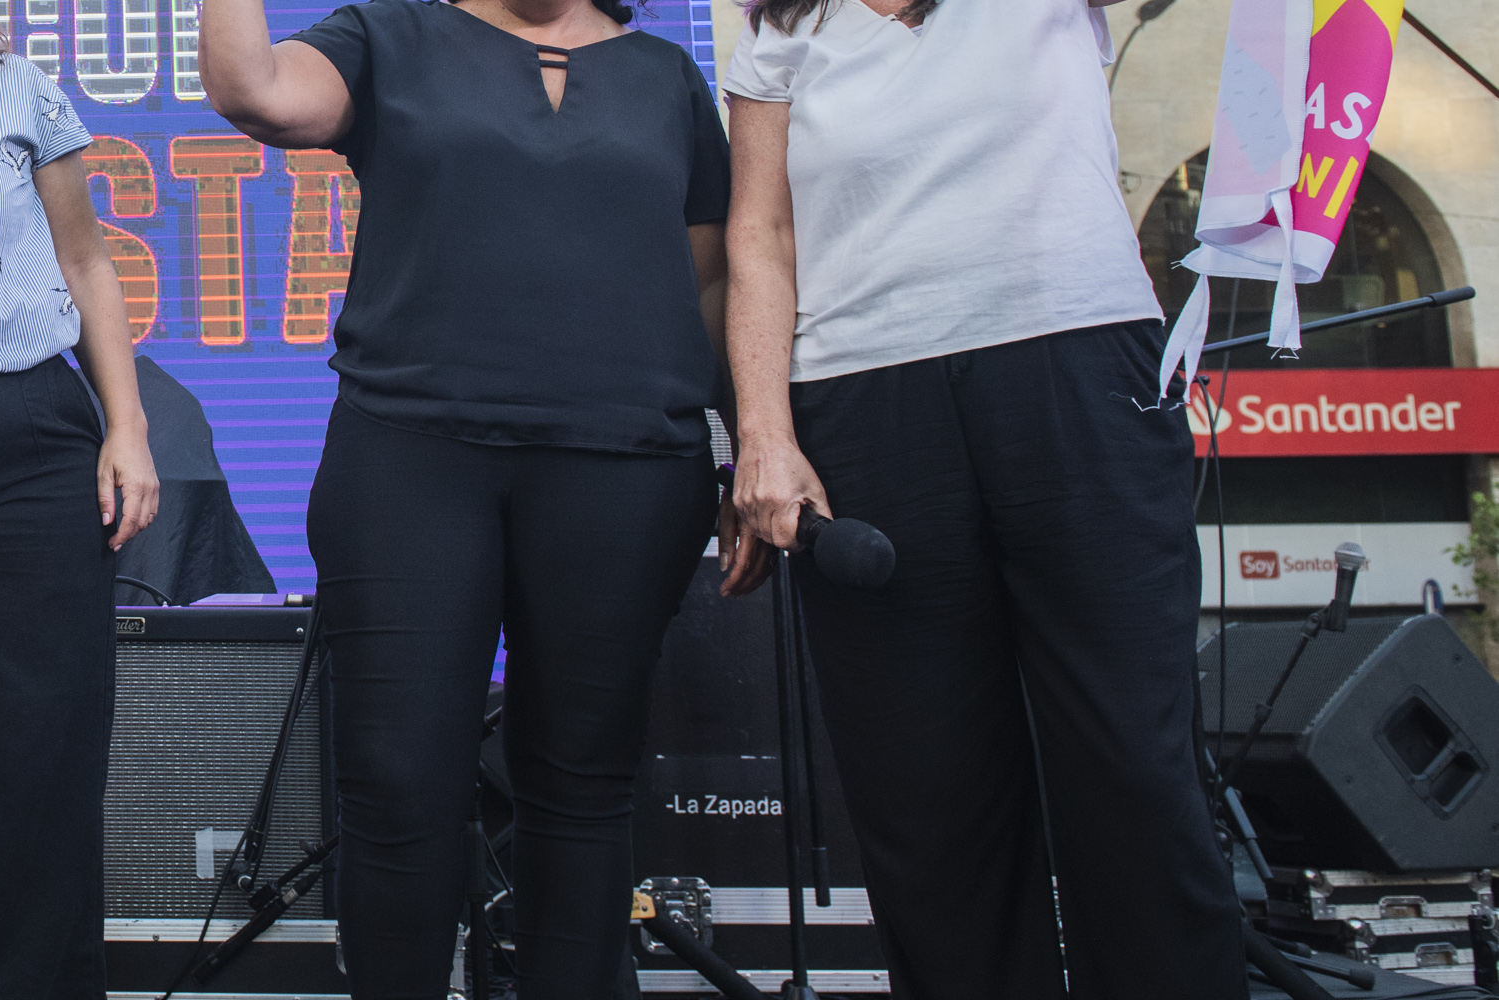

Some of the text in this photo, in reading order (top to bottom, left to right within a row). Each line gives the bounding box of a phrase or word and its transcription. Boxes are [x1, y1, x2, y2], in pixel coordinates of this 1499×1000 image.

[1304, 82, 1372, 140] AS
[1238, 393, 1462, 434] Santander
[1243, 555, 1276, 578] Soy
[704, 794, 785, 820] Zapada
